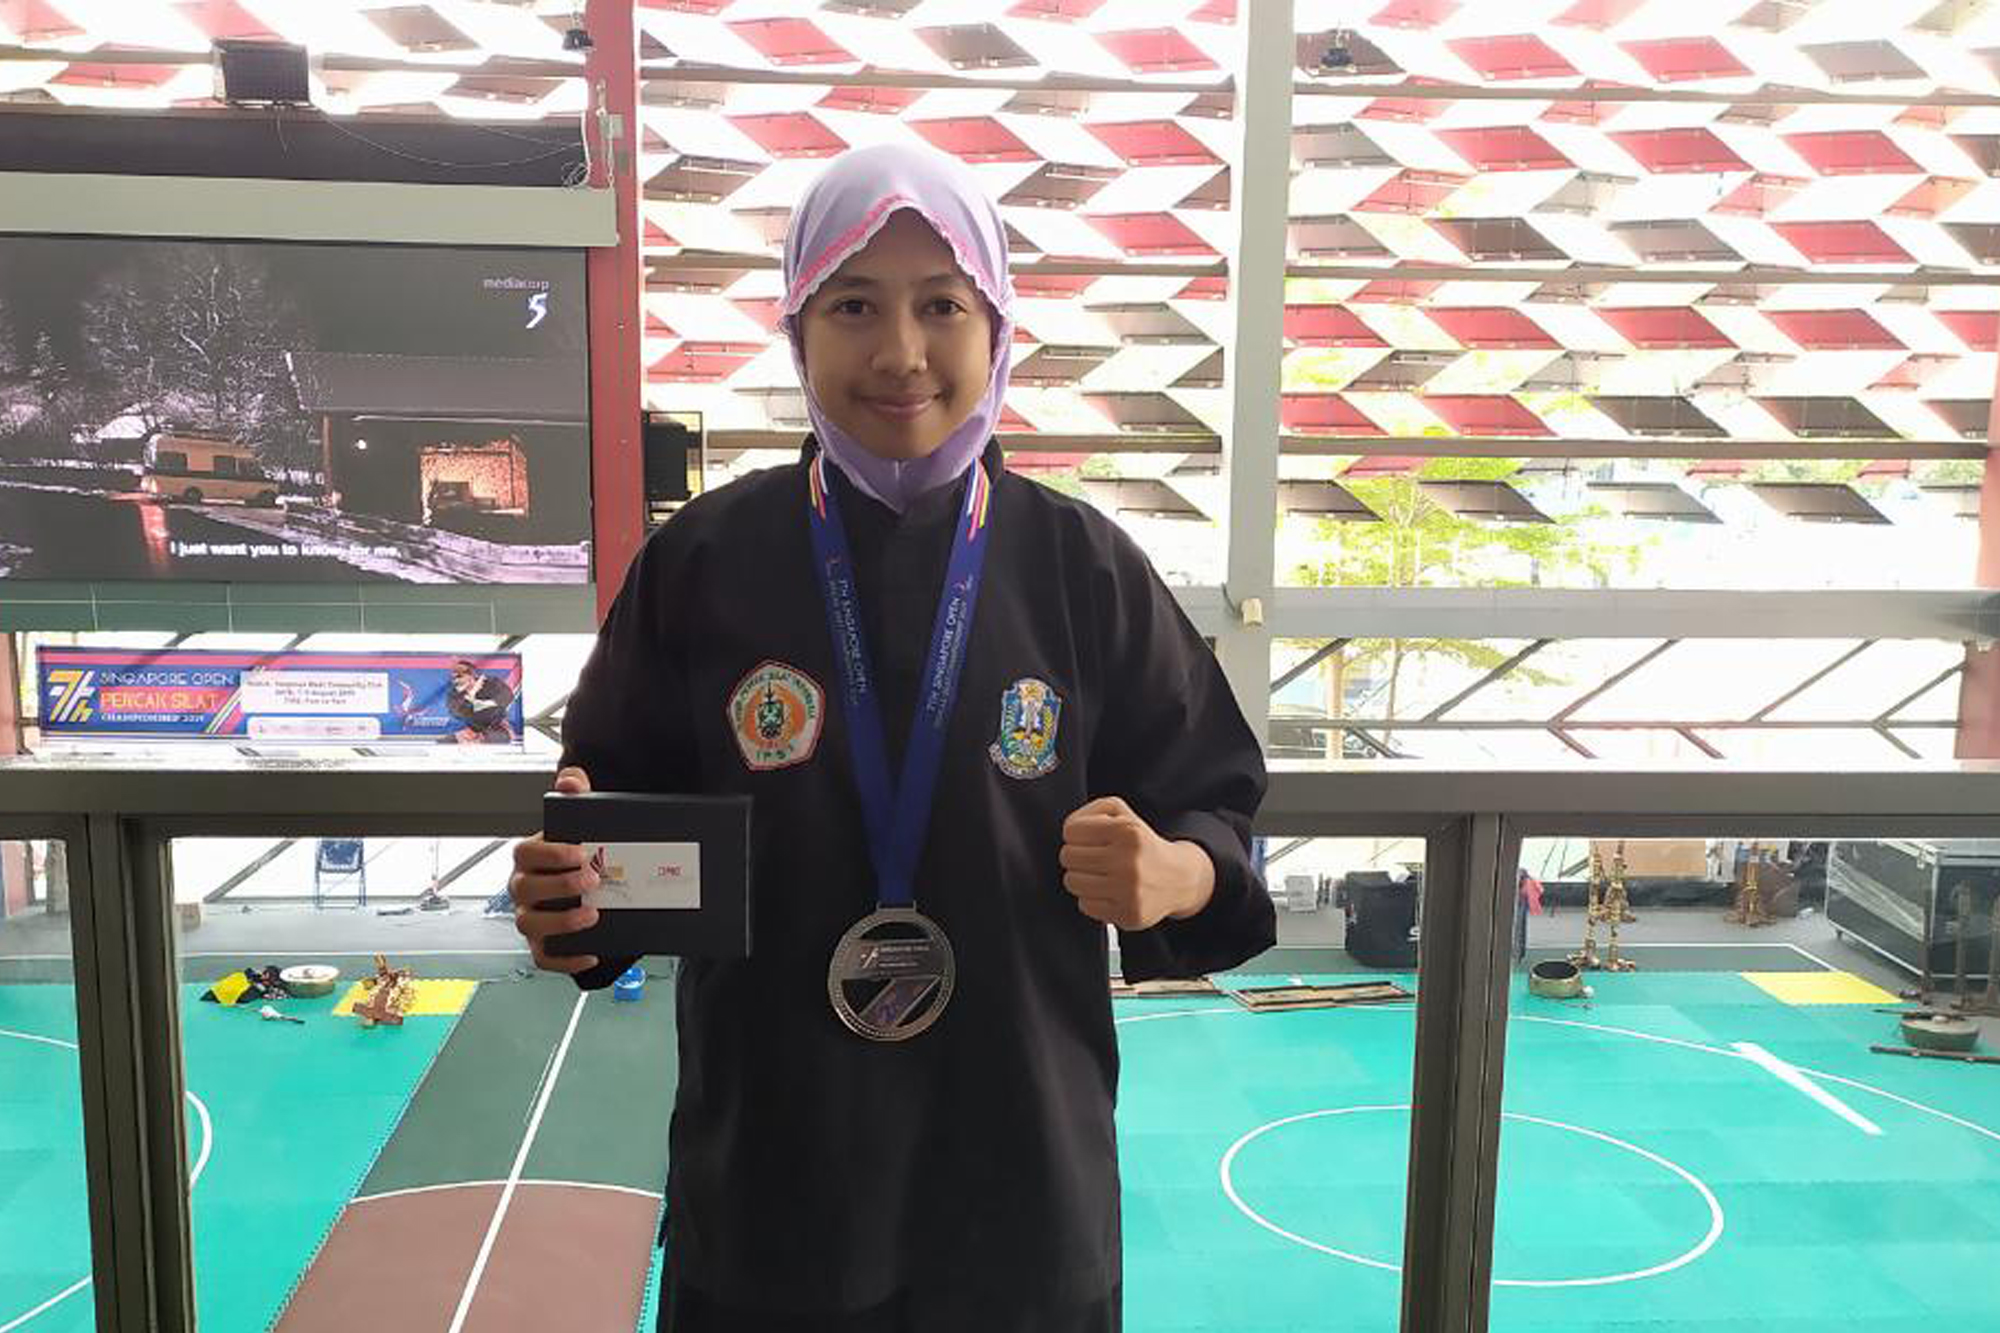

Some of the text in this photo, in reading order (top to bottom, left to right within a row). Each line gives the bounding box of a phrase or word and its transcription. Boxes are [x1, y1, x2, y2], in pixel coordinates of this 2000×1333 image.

[526, 292, 548, 329] 5
[170, 541, 175, 554] I
[179, 542, 208, 557] just
[209, 544, 248, 555] want
[249, 545, 279, 557] you
[281, 544, 298, 555] to
[946, 597, 961, 626] OPEN
[101, 672, 187, 686] SINGAPORE
[191, 672, 234, 686] OPEN
[100, 692, 219, 709] PENCAK SILAT
